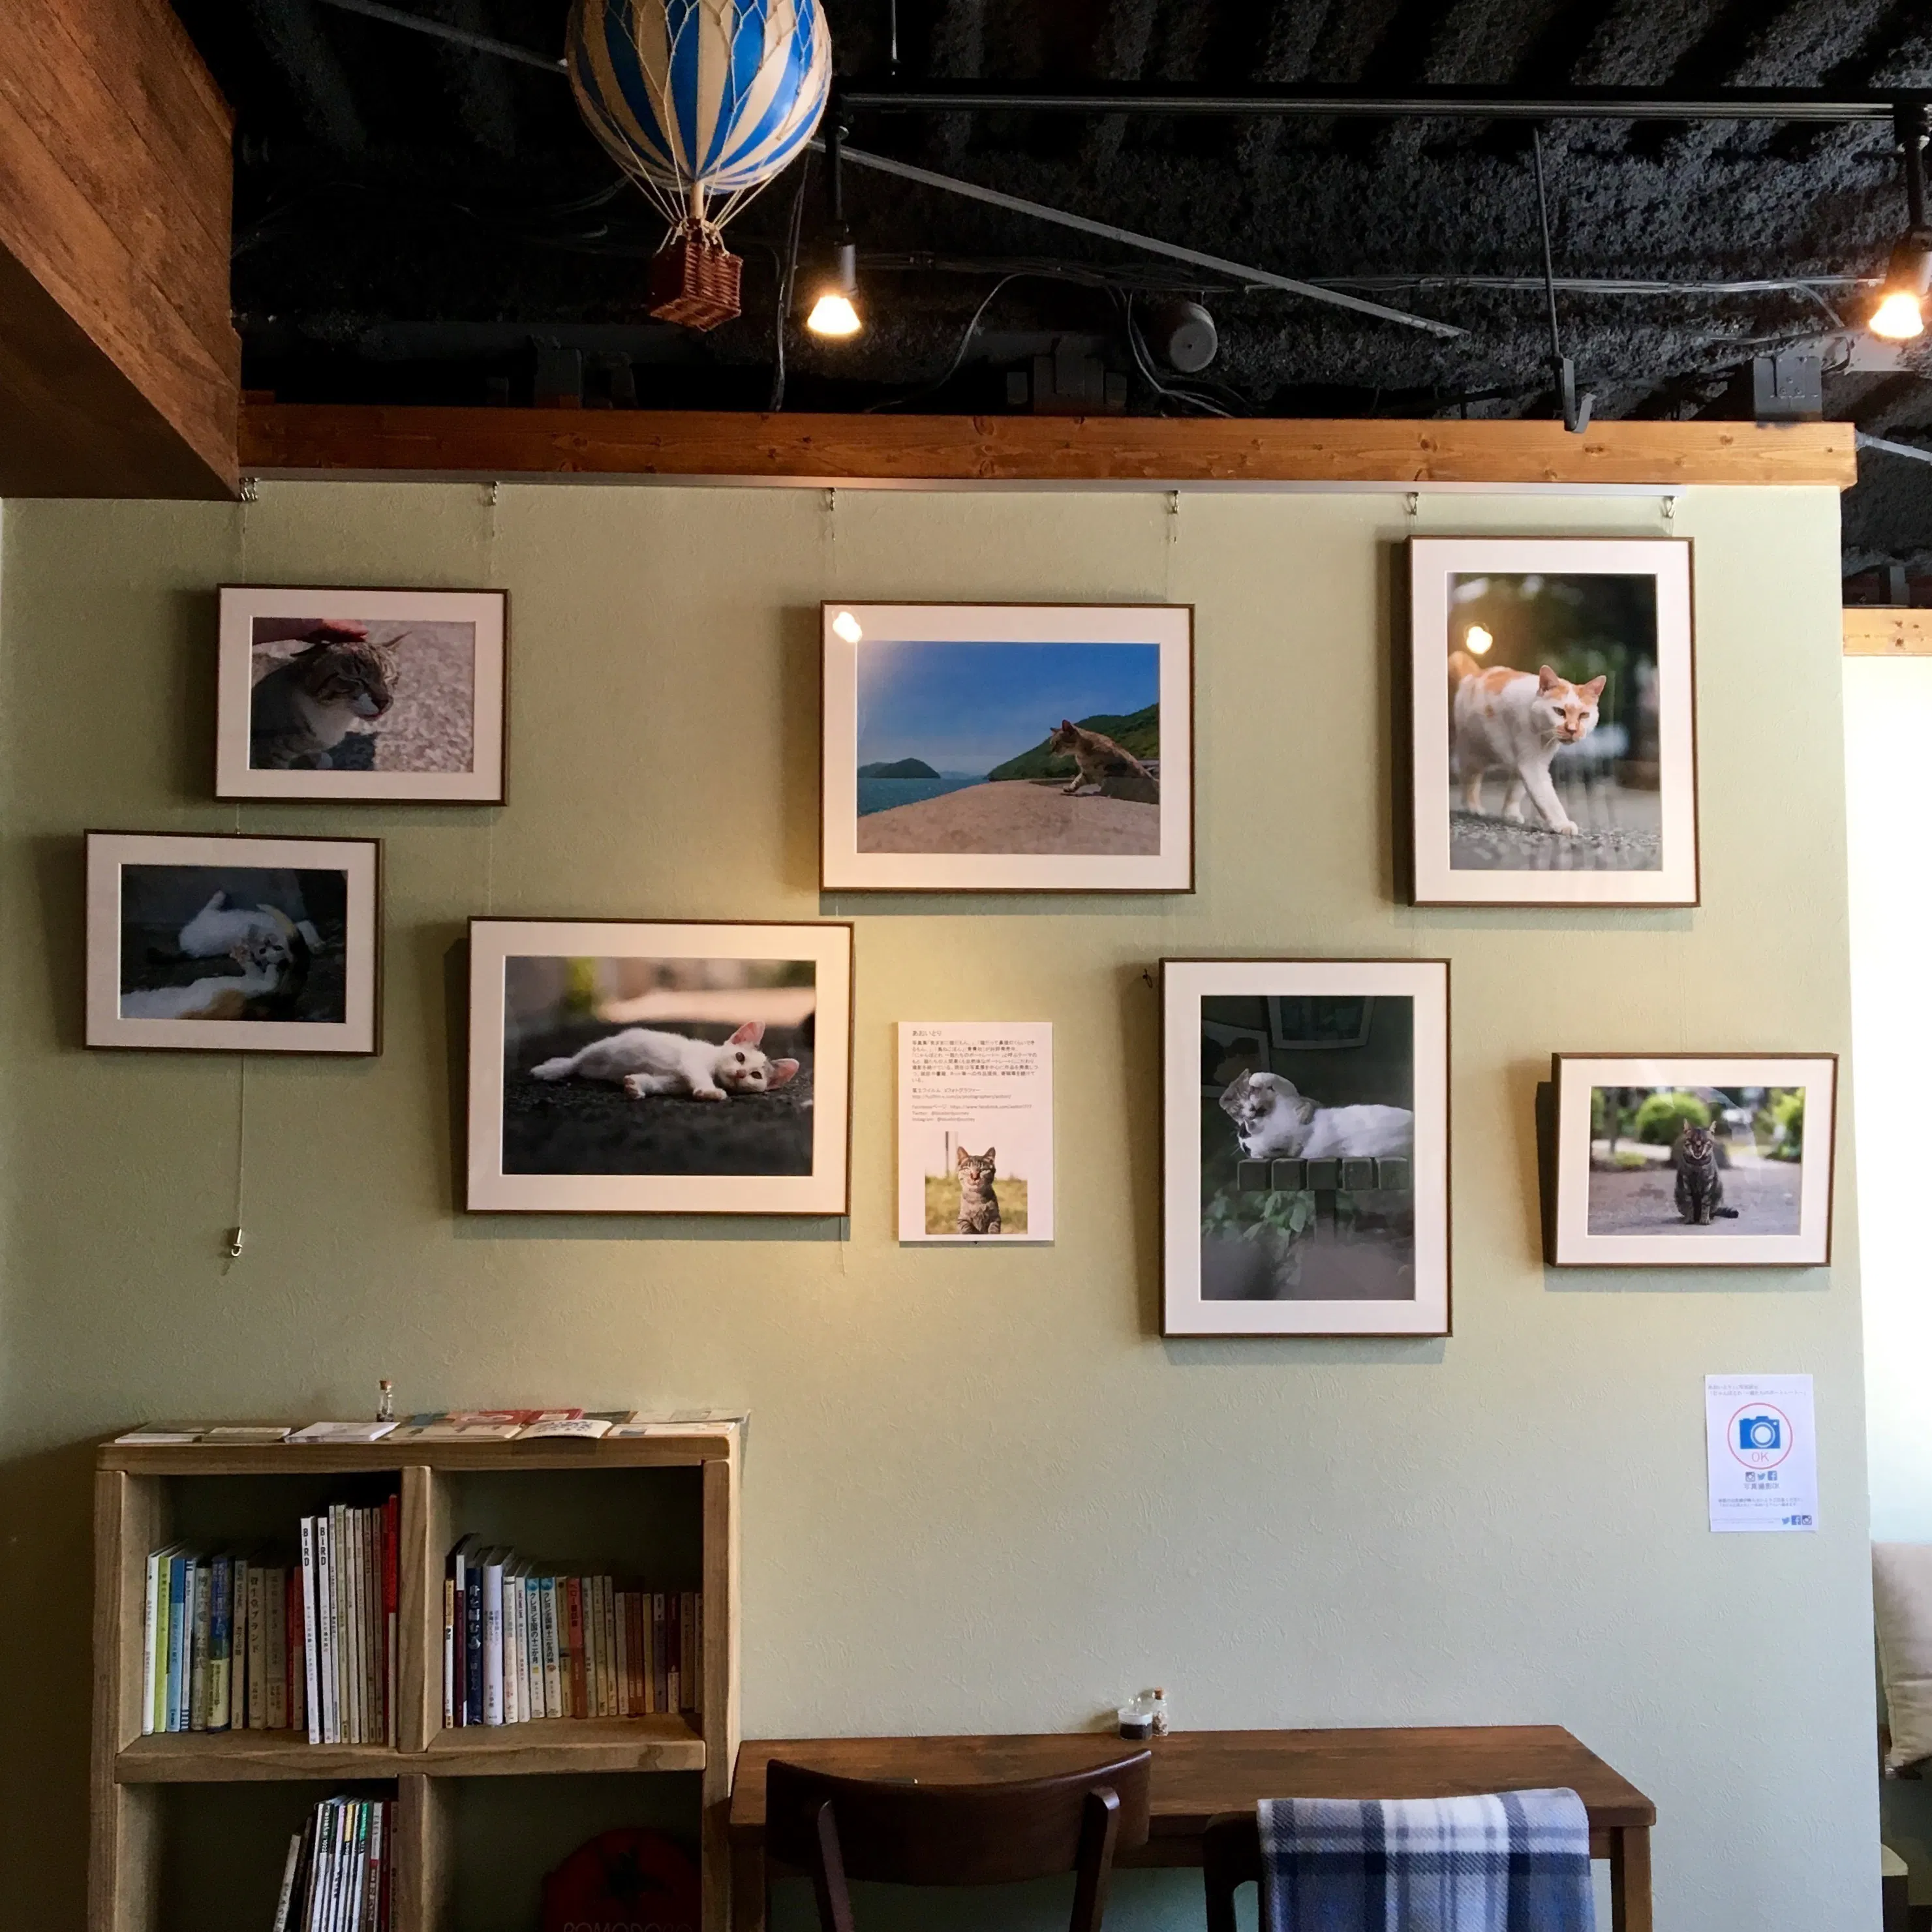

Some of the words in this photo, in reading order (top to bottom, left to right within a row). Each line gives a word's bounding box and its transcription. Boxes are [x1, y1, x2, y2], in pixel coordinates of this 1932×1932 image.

[1751, 1451, 1770, 1462] OK
[1743, 1482, 1781, 1490] 写真撮影OK
